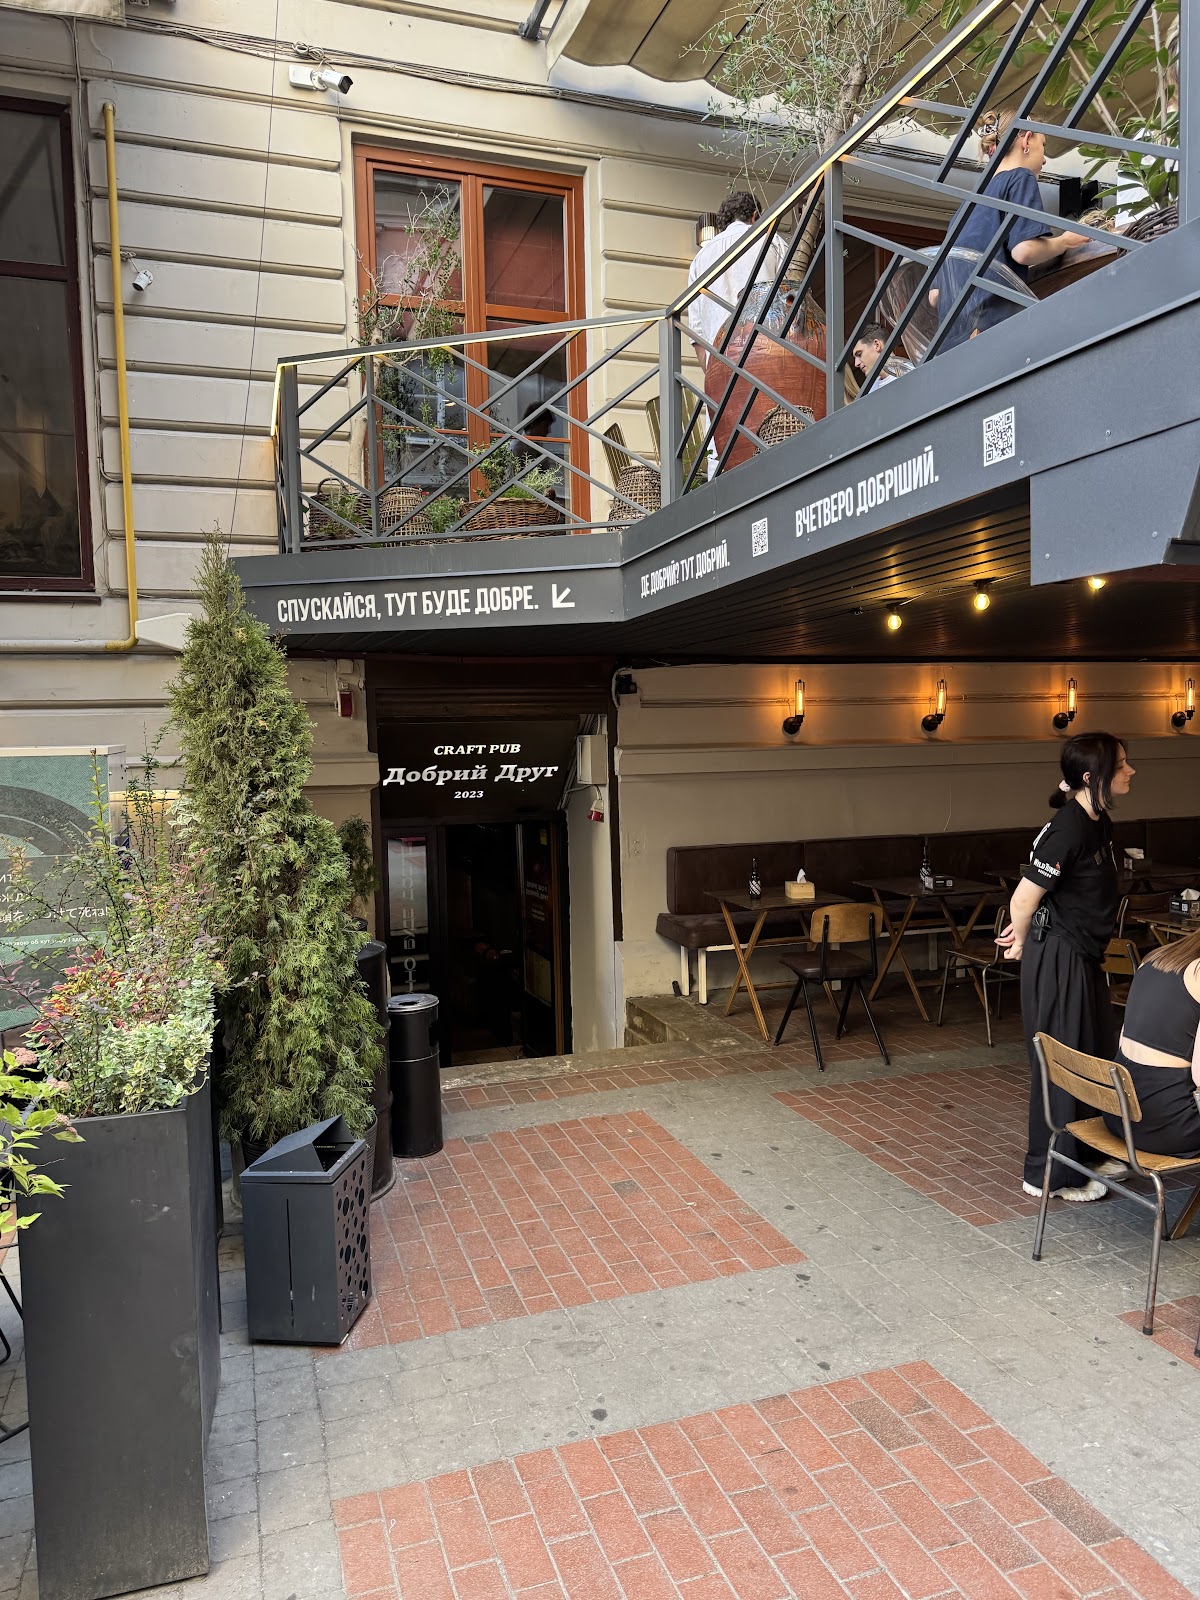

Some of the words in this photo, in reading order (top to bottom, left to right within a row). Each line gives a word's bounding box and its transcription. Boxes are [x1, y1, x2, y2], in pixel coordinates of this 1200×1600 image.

[795, 487, 854, 538] ВЧЕТВЕРО
[856, 445, 939, 516] ДОБРІШИЙ.
[640, 574, 650, 598] ДЕ
[650, 560, 680, 595] ДОБРИЙ?
[680, 556, 695, 581] ТУТ
[696, 539, 730, 579] ДОБРИЙ.
[277, 591, 382, 623] СПУСКАЙСЯ,
[385, 592, 418, 617] ТУТ
[422, 589, 471, 617] БУДЕ
[474, 585, 539, 615] ДОБРЕ.
[433, 744, 487, 756] CRAFT
[489, 743, 521, 754] PUB
[382, 764, 488, 786] Добрий
[494, 764, 558, 782] Друг
[454, 790, 484, 799] 2023
